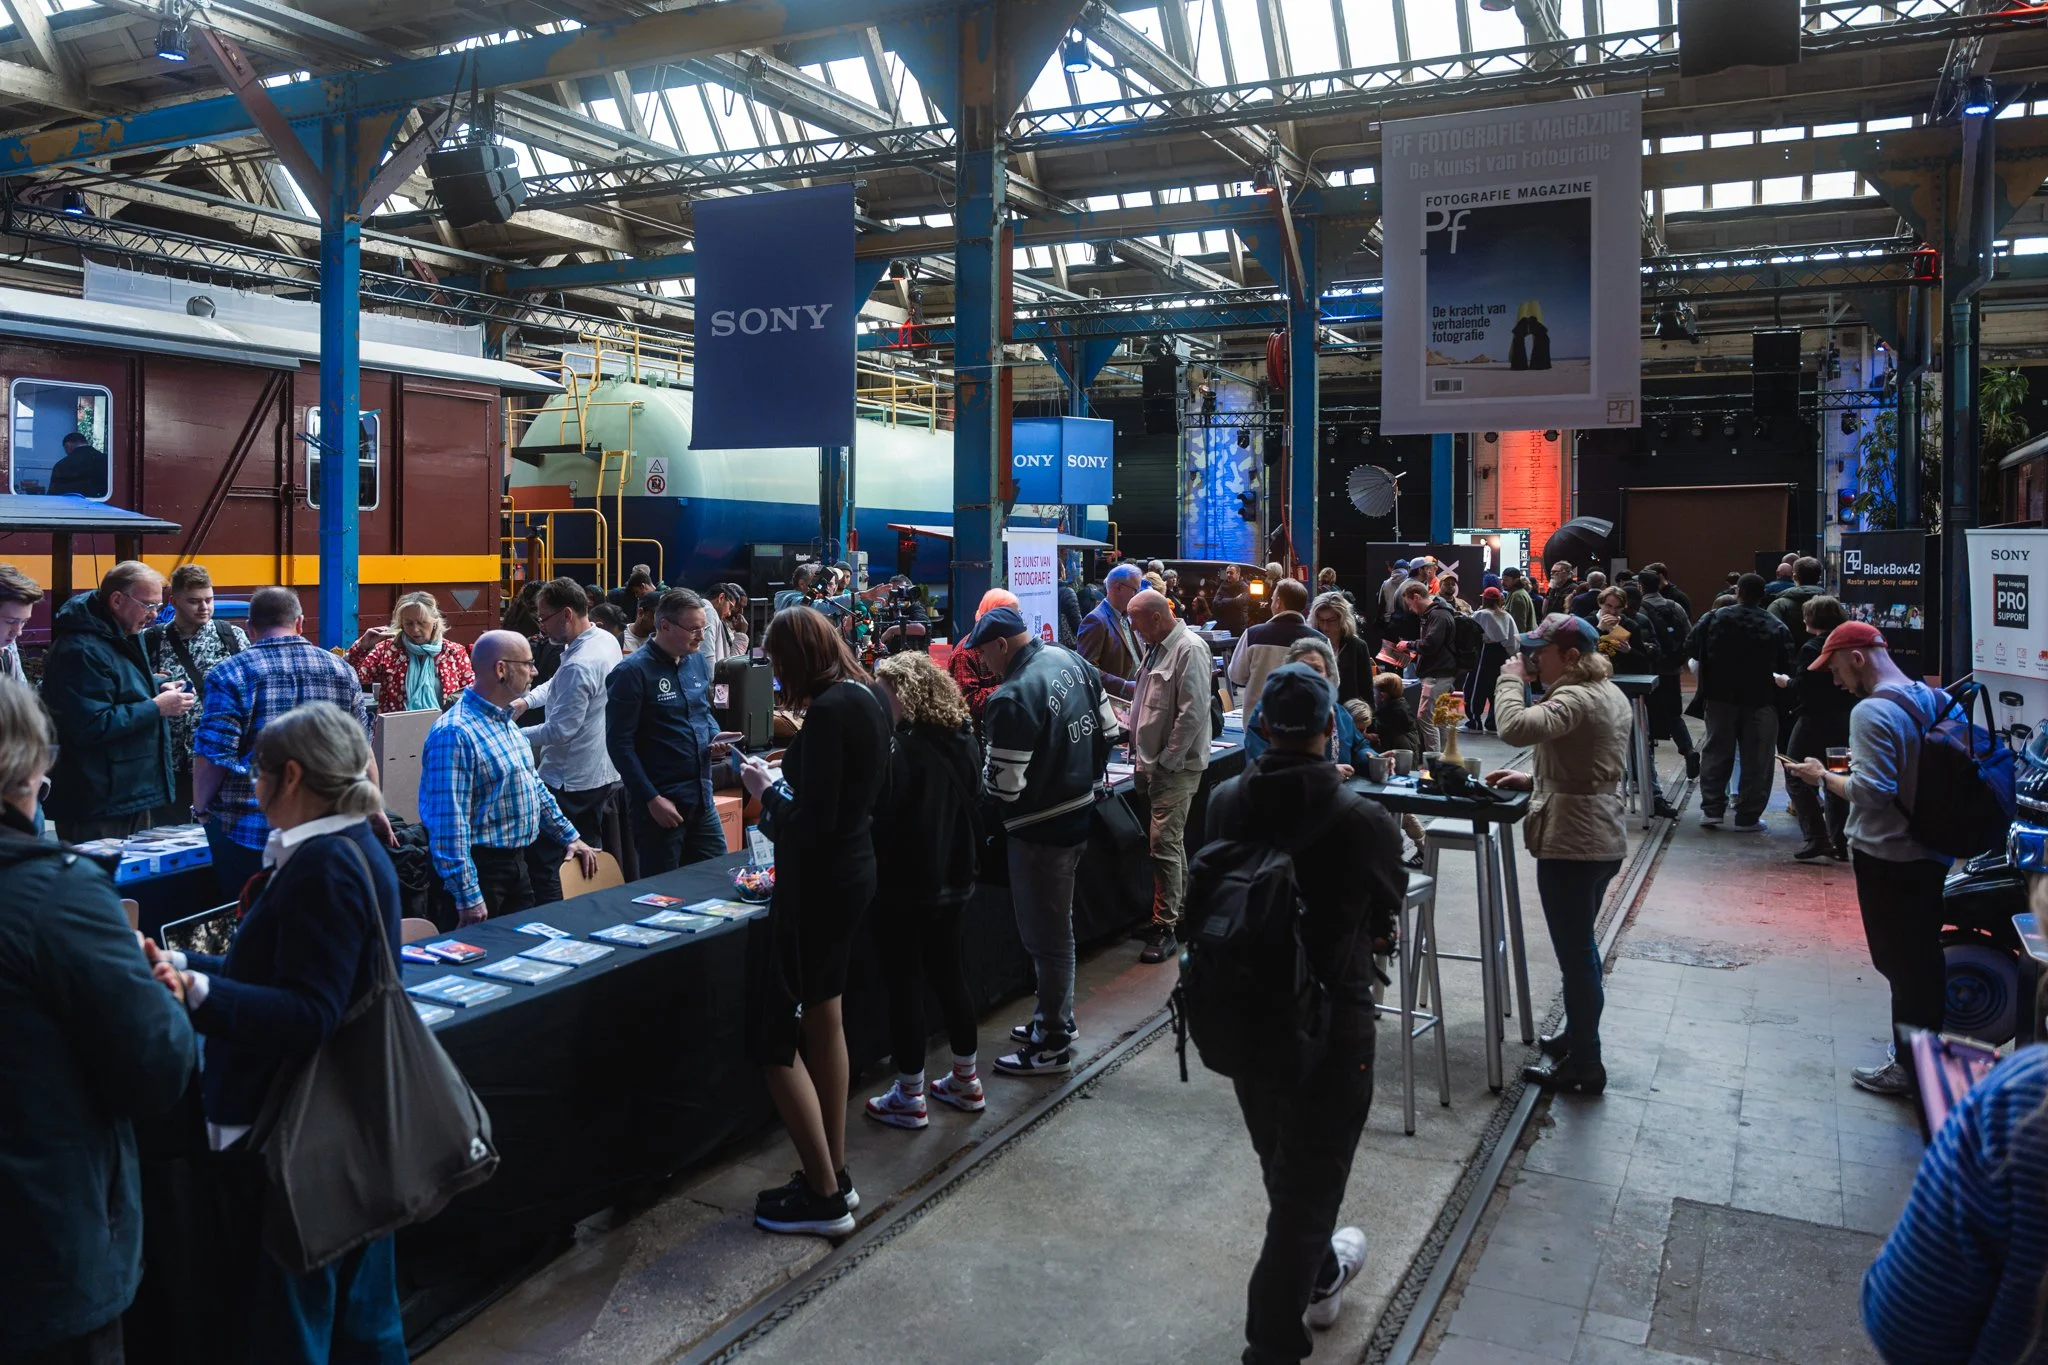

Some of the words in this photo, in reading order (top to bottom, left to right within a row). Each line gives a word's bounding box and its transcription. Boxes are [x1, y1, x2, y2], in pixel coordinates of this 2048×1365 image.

[1392, 134, 1413, 157] PF
[1419, 121, 1526, 154] FOTOGRAFIE
[1531, 110, 1631, 141] MAGAZINE
[1409, 162, 1429, 180] De
[1486, 154, 1517, 171] van
[1522, 142, 1611, 169] Fotografie
[1426, 189, 1511, 207] FOTOGRAFIE
[1517, 181, 1592, 199] MAGAZINE
[1422, 209, 1471, 254] Pf
[1432, 306, 1446, 318] De
[1449, 303, 1485, 317] kracht
[1487, 304, 1506, 314] van
[711, 303, 833, 336] SONY
[1432, 316, 1491, 330] verhalende
[1432, 329, 1485, 344] fotografie
[1013, 454, 1055, 468] ONY
[1067, 454, 1109, 469] SONY
[1014, 556, 1021, 568] DE
[1022, 556, 1039, 568] KUNST
[1040, 556, 1051, 567] VAN
[1991, 549, 2031, 561] SONY
[1863, 563, 1921, 575] BlackBox42
[1014, 571, 1051, 586] FOTOGRAFIE
[1867, 579, 1880, 587] your
[1882, 578, 1896, 587] Sony
[1997, 580, 2009, 588] Sony
[2009, 580, 2026, 589] Imaging
[1997, 591, 2026, 611] PRO
[1997, 611, 2026, 622] SUPPORT
